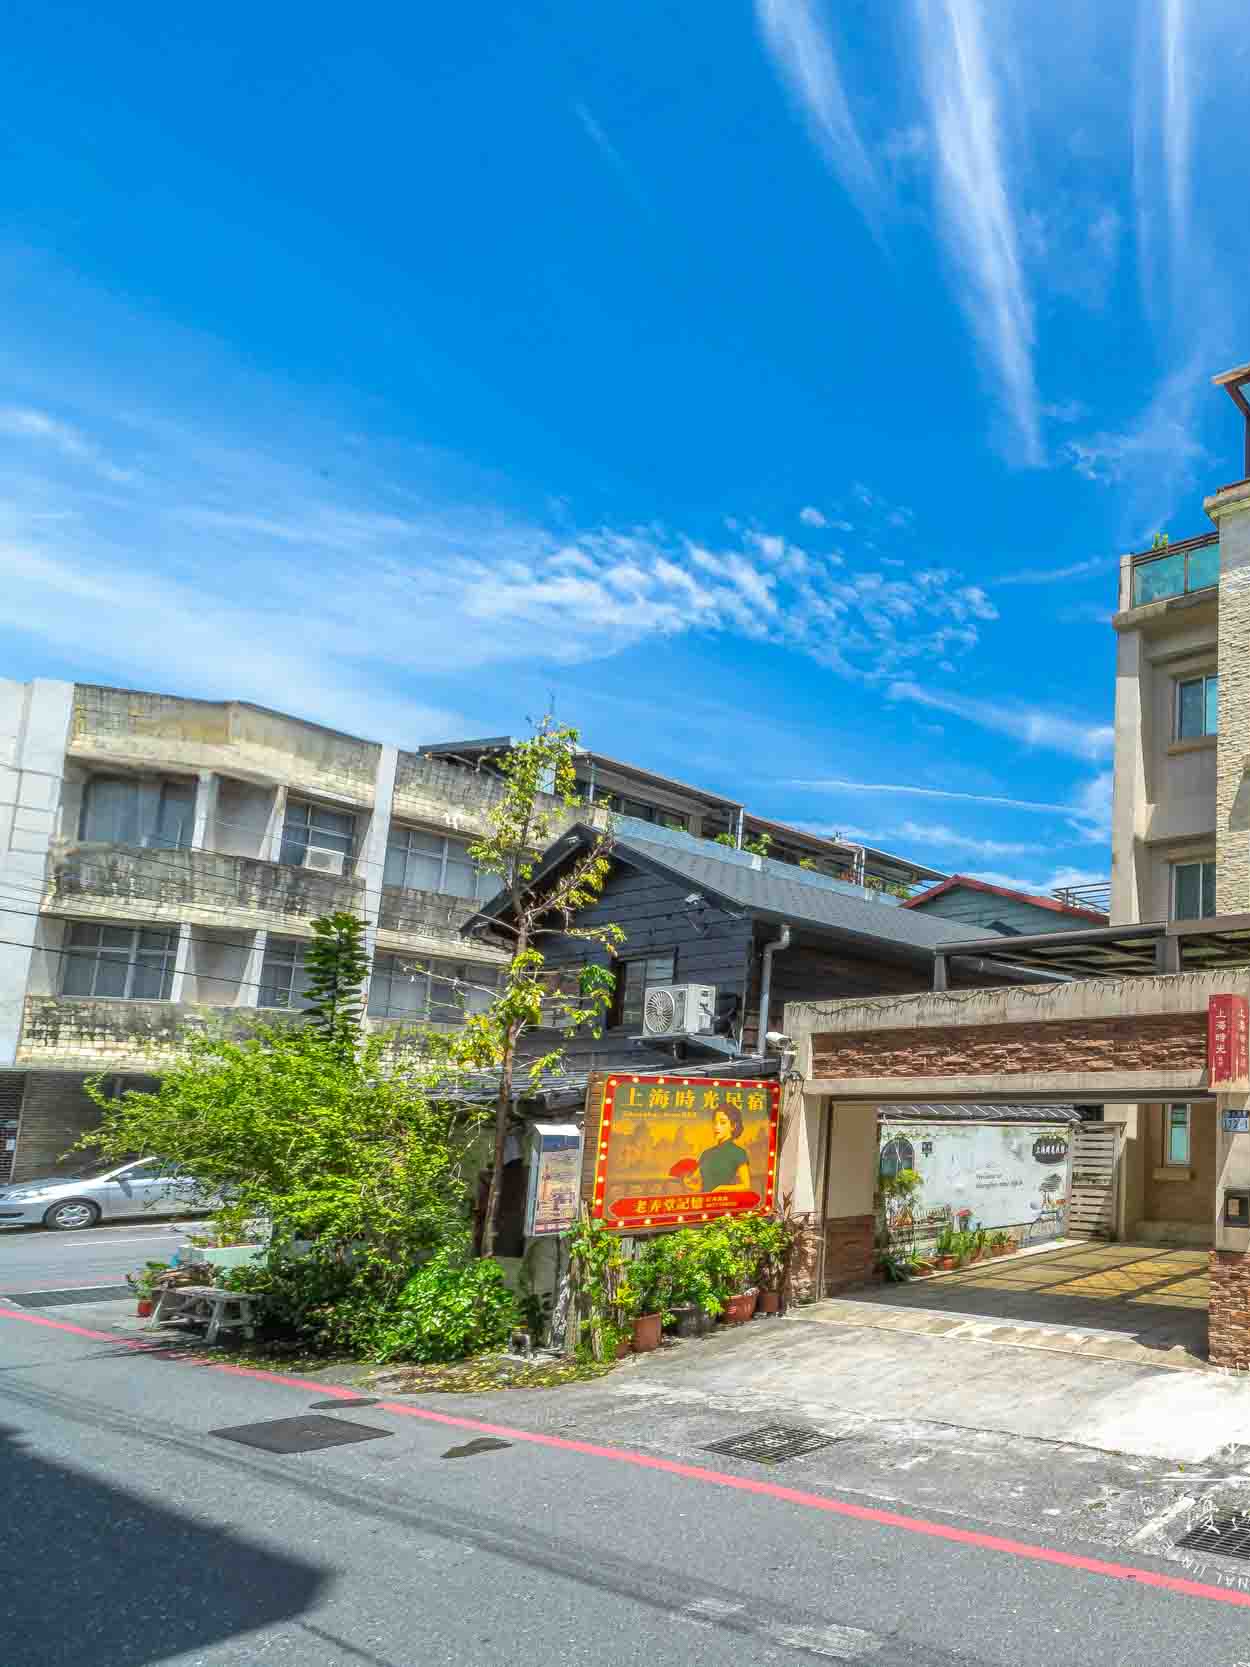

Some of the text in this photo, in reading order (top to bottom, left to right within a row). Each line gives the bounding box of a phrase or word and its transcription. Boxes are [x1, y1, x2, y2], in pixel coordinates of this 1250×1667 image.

[623, 1087, 768, 1112] 上海時光民宿
